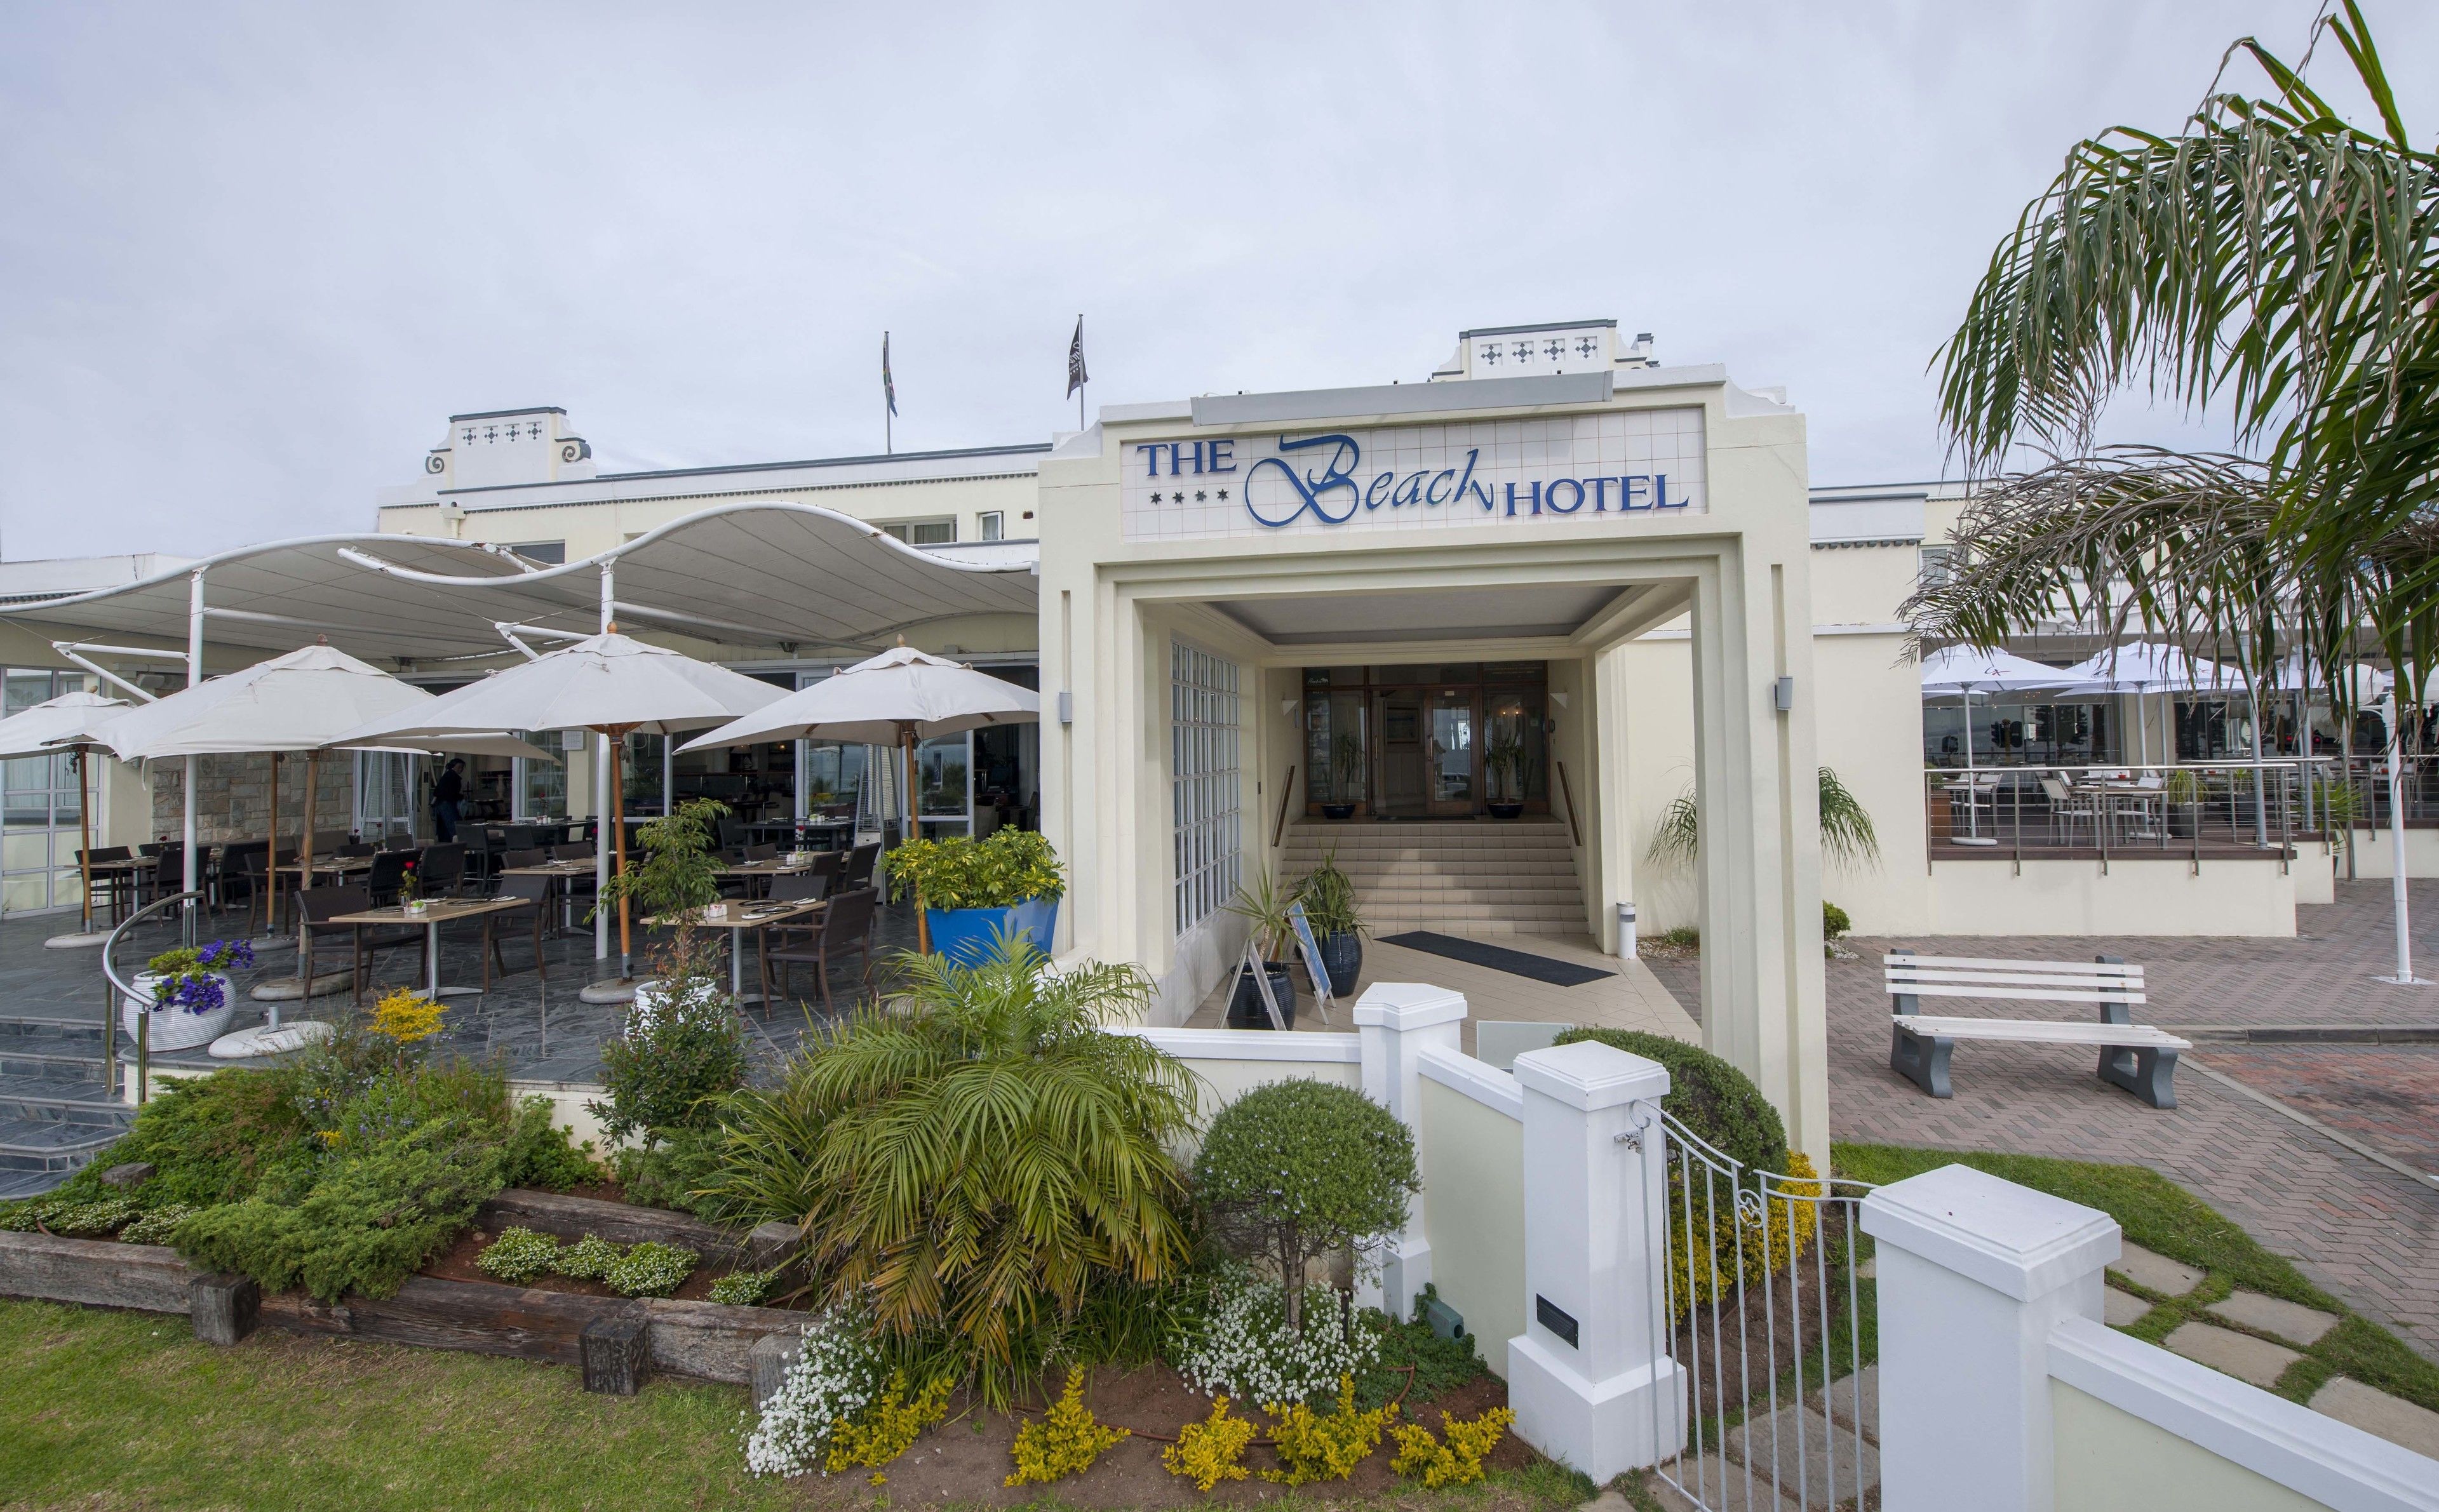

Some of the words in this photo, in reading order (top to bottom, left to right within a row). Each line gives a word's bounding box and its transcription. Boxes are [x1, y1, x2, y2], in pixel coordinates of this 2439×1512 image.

[1136, 439, 1237, 476] THE
[1245, 434, 1494, 528] Beach
[1505, 474, 1690, 516] HOTEL
